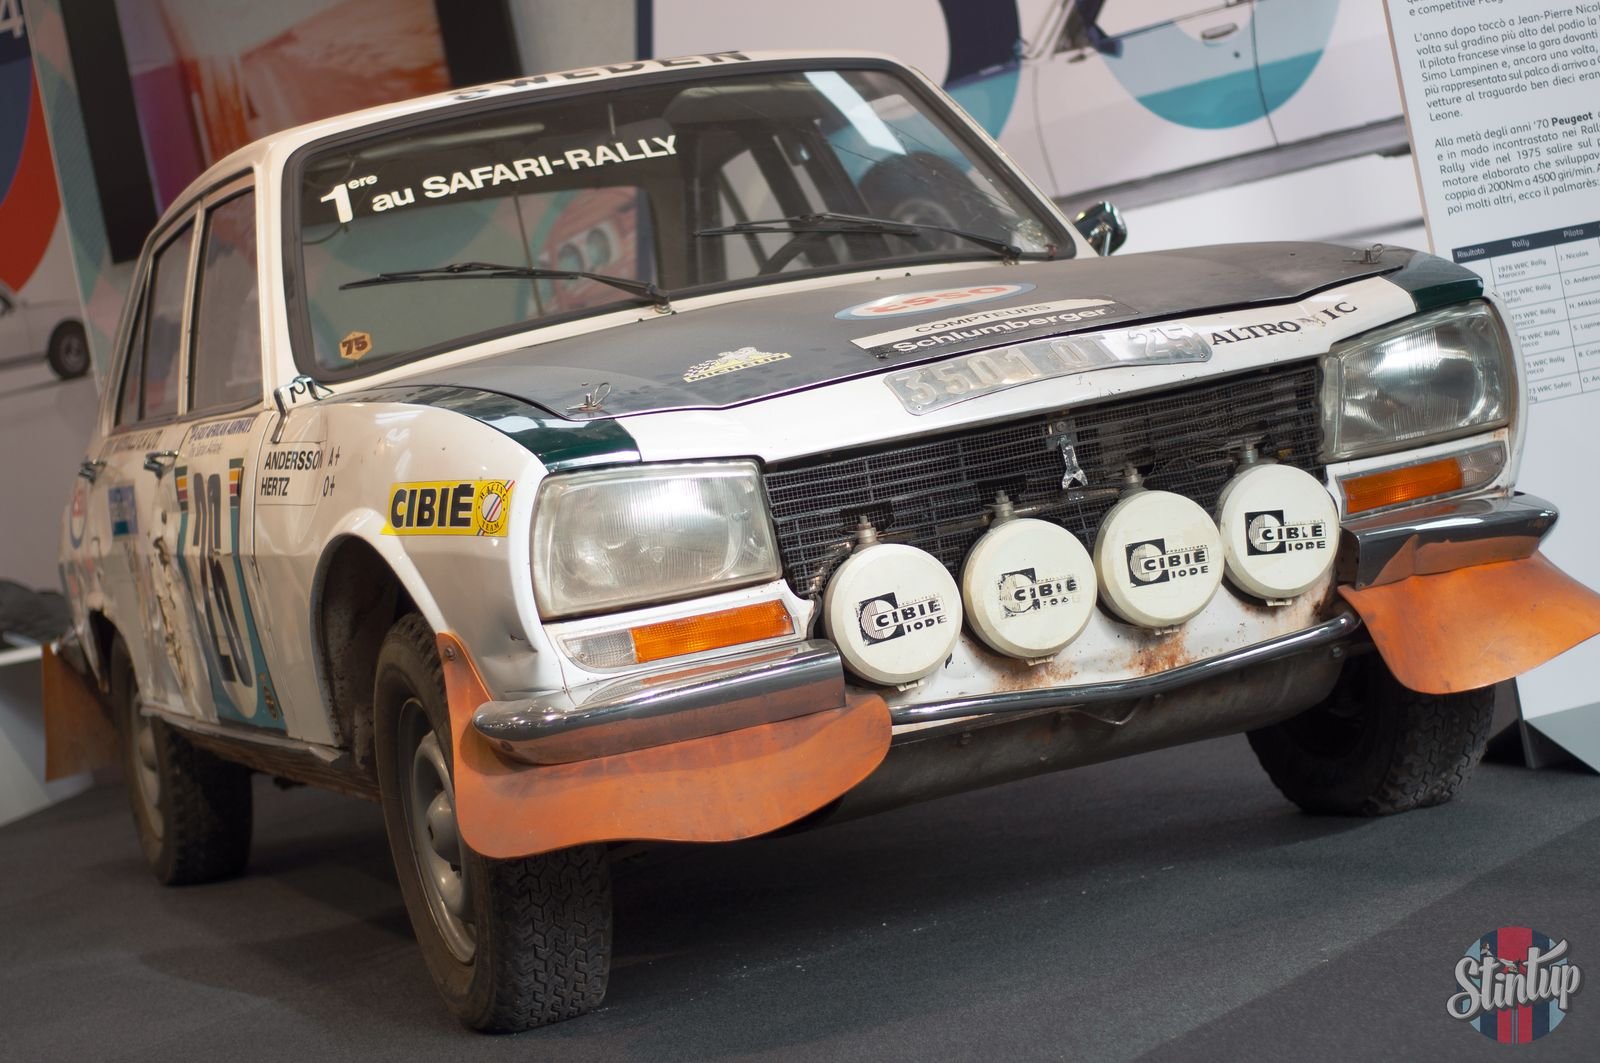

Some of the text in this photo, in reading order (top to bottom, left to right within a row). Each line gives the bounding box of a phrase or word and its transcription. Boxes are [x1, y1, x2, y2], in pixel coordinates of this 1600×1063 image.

[1417, 0, 1476, 14] competitive
[1414, 30, 1448, 42] L'anno
[1451, 25, 1476, 37] dopo
[1478, 18, 1506, 32] toccò
[1518, 9, 1573, 25] Jean-Pierre
[1416, 16, 1597, 55] volta sul gradino più alto del podio la
[1421, 44, 1598, 81] Simo Lampinen e, ancora una volta,
[1428, 56, 1456, 69] pilota
[1458, 49, 1499, 62] francese
[1501, 44, 1526, 54] vinse
[1527, 41, 1537, 50] la
[1539, 38, 1561, 50] gara
[1563, 29, 1598, 44] davanti
[1425, 84, 1439, 97] più
[1441, 73, 1507, 93] rappresentata
[1509, 69, 1522, 80] sul
[1524, 66, 1550, 80] palco
[1551, 63, 1560, 73] di
[1561, 59, 1588, 71] arrivo
[1590, 58, 1596, 66] a
[1426, 95, 1462, 108] vetture
[1465, 91, 1476, 102] al
[1478, 83, 1527, 99] traguardo
[1530, 80, 1549, 90] ben
[1552, 73, 1575, 86] dieci
[1429, 110, 1463, 121] Leone.
[1435, 137, 1454, 148] Alla
[1456, 131, 1482, 144] metà
[1484, 126, 1508, 139] degli
[1510, 122, 1531, 135] anni
[1533, 118, 1549, 129] '70
[1551, 111, 1593, 127] Peugeot
[1440, 162, 1465, 175] Rally
[1470, 157, 1491, 169] vide
[1495, 153, 1511, 165] nel
[1516, 147, 1541, 160] 1975
[1546, 142, 1573, 155] salire
[1578, 138, 1592, 149] sul
[1447, 150, 1457, 160] in
[1460, 145, 1489, 157] modo
[1493, 132, 1559, 151] incontrastato
[1562, 127, 1577, 138] nei
[1580, 122, 1600, 135] Rall
[372, 187, 415, 212] au
[422, 134, 677, 199] SAFARI-RALLY
[1442, 174, 1479, 188] motore
[1482, 165, 1530, 180] elaborato
[1533, 160, 1551, 171] che
[1445, 188, 1476, 201] coppia
[1478, 184, 1487, 195] di
[1488, 179, 1523, 193] 200Nm
[1533, 171, 1556, 184] 4500
[1558, 166, 1595, 181] giri/min.
[1447, 202, 1463, 216] poi
[1465, 197, 1491, 211] molti
[1493, 193, 1516, 205] altri,
[1518, 190, 1541, 200] ecco
[1543, 186, 1550, 196] il
[1457, 229, 1584, 258] Risultato Rally Pilota
[892, 308, 1106, 352] Schlumberger
[915, 305, 1051, 333] COMPTEURS
[342, 335, 368, 356] 75
[896, 347, 1041, 406] 3501
[260, 476, 290, 497] HERTZ
[482, 520, 501, 532] TEAM
[1288, 540, 1326, 552] IODE
[1171, 565, 1209, 579] IODE
[906, 614, 947, 633] IODE
